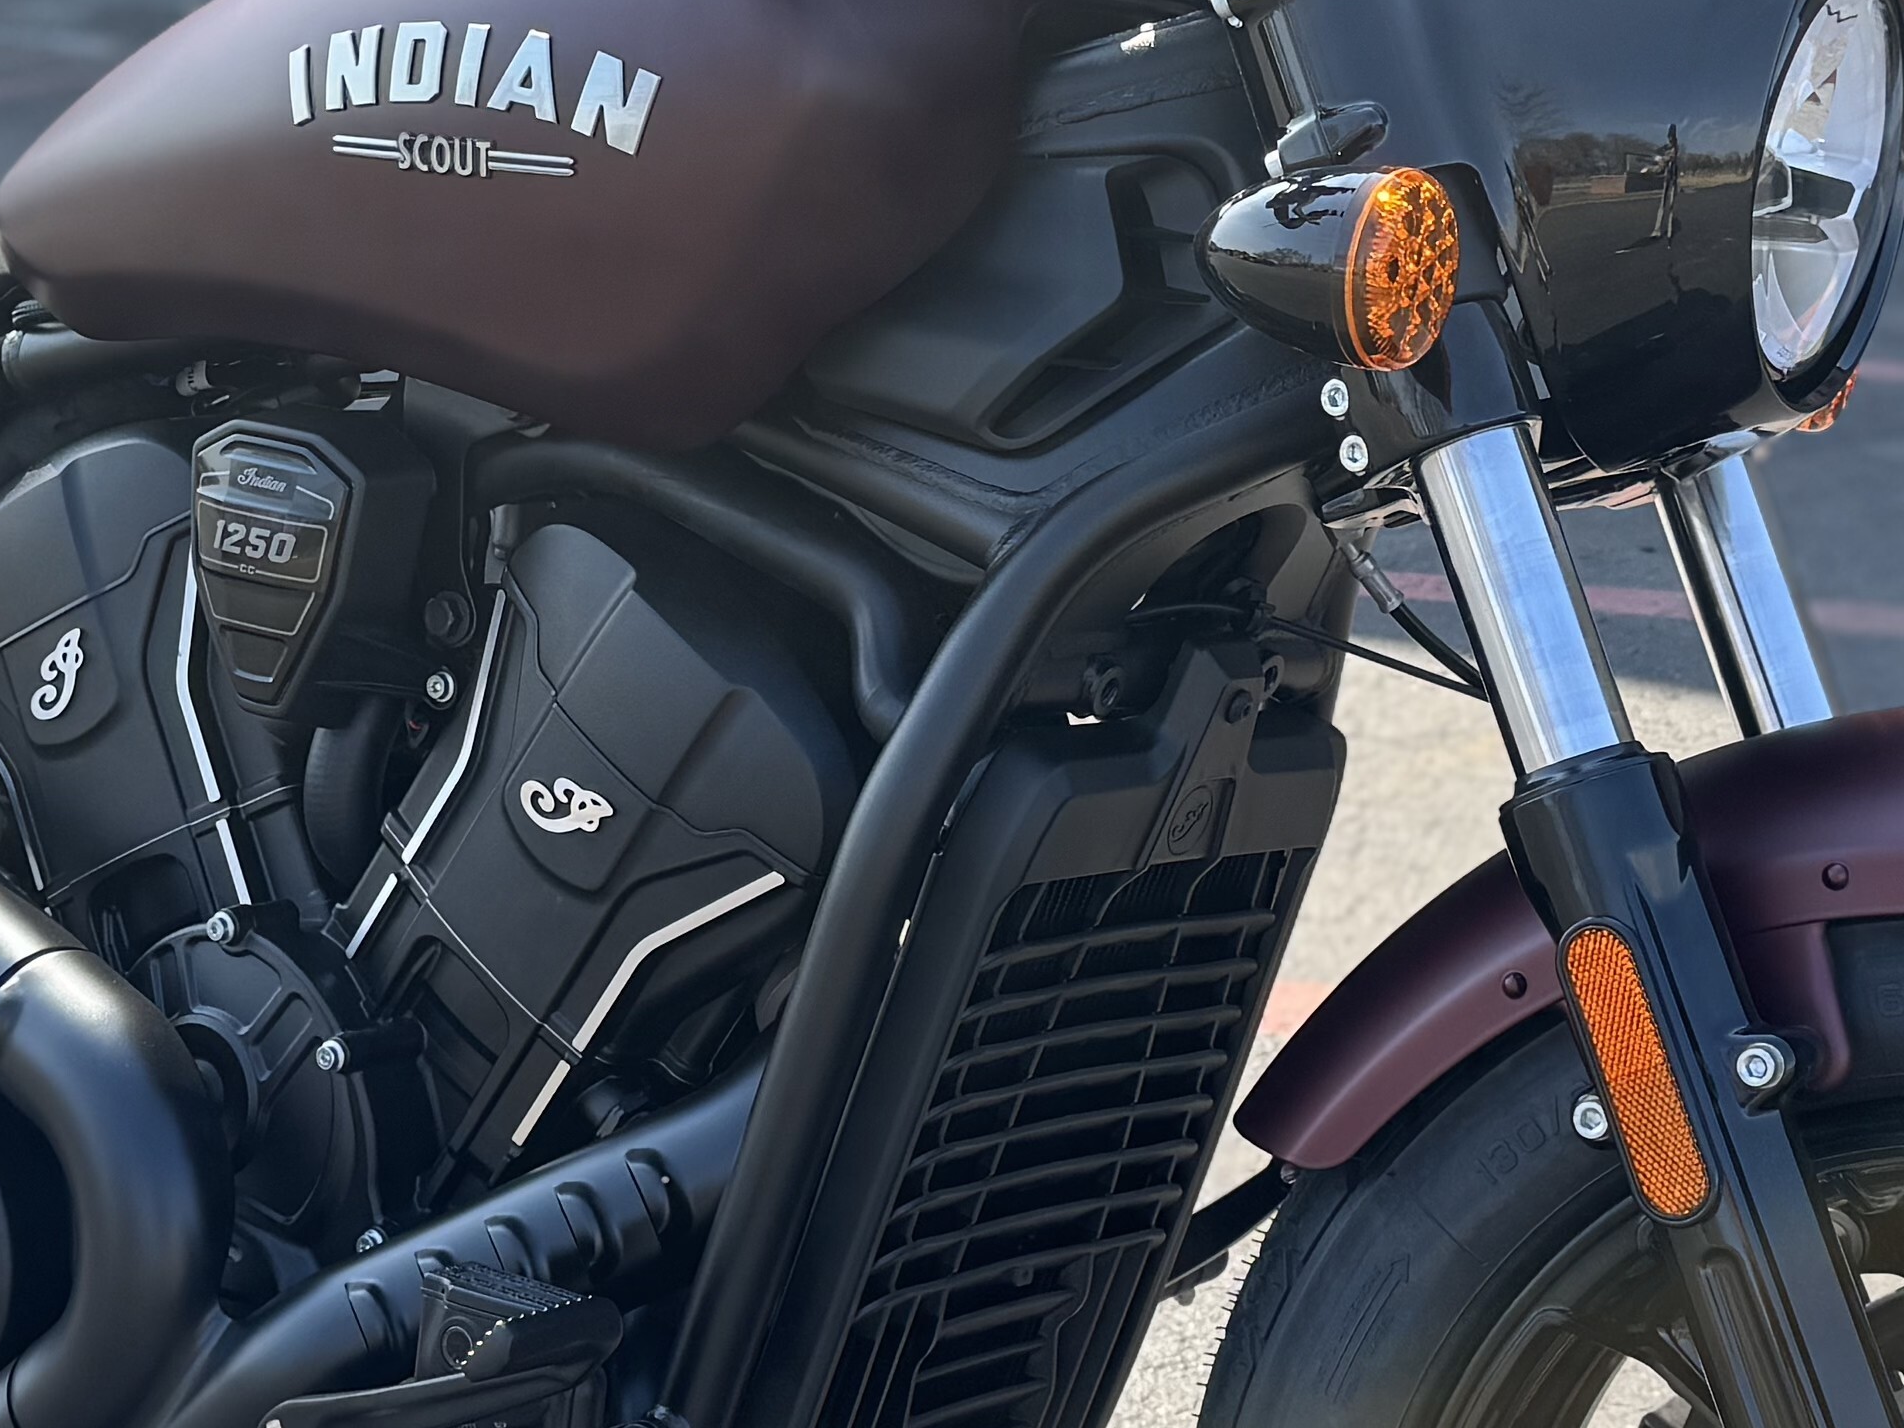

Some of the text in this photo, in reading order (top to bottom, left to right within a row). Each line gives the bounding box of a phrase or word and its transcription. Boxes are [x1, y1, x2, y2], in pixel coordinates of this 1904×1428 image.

[288, 20, 662, 156] INDIAN
[397, 131, 493, 179] SCOUT
[237, 467, 287, 494] Indian
[213, 519, 296, 564] 1250
